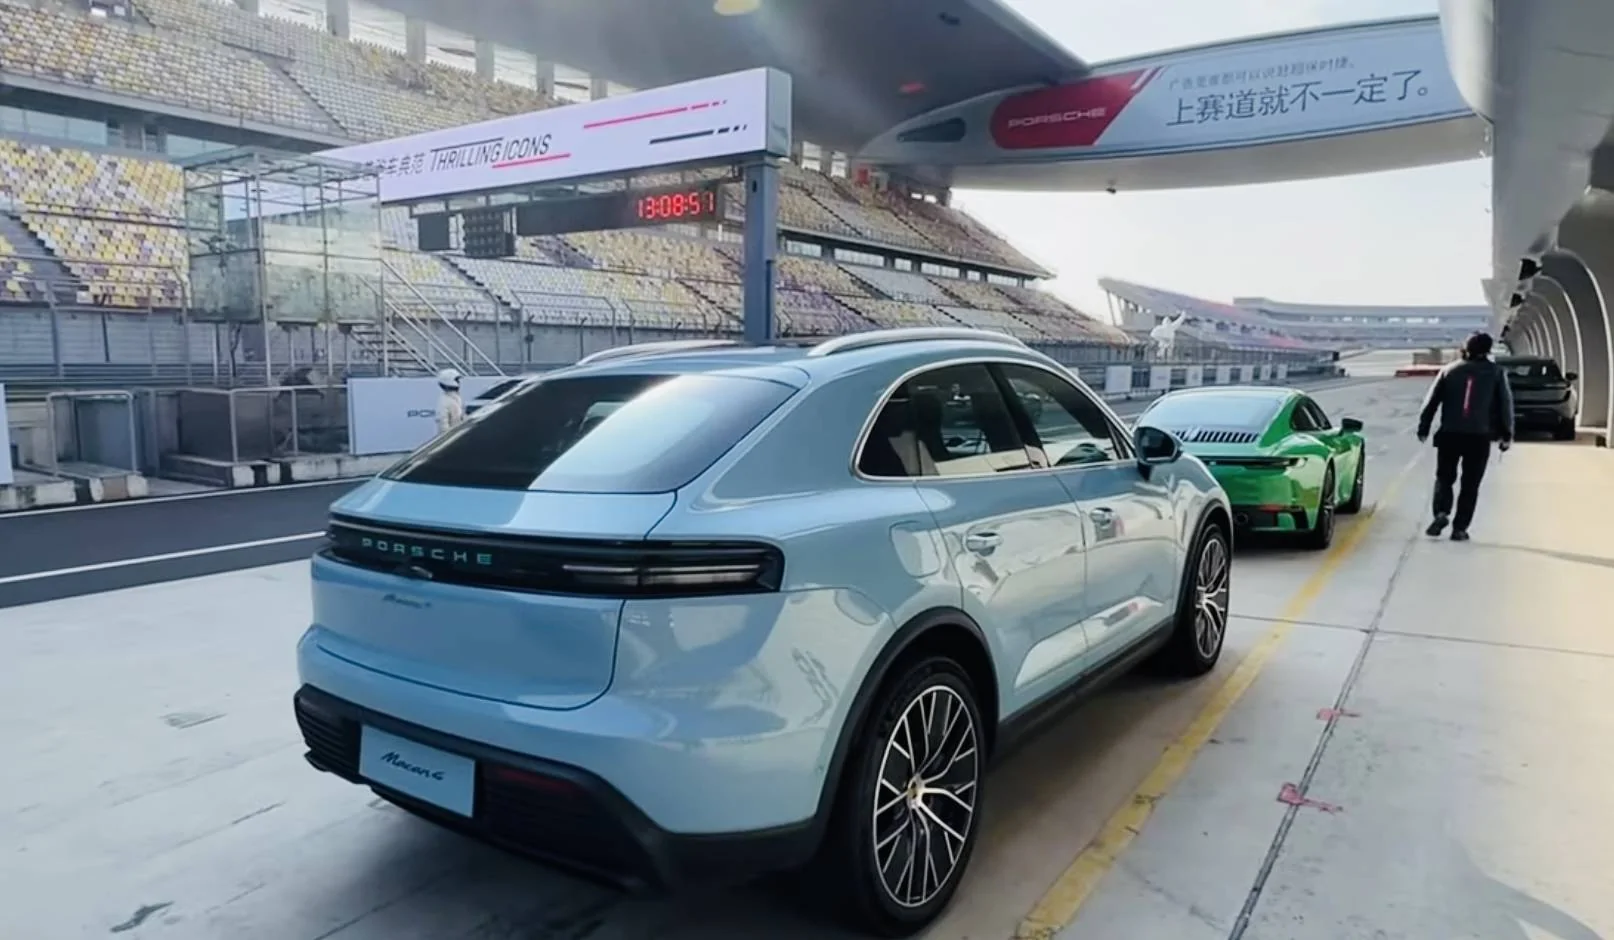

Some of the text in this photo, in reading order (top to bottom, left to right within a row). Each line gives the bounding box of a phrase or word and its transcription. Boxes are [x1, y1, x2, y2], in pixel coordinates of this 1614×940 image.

[1166, 70, 1429, 126] 上赛道就不一定了。
[1007, 106, 1106, 130] PORSCHE
[429, 134, 552, 171] THRILLING ICONS
[362, 537, 494, 565] PORSCHE
[381, 751, 430, 778] Macan
